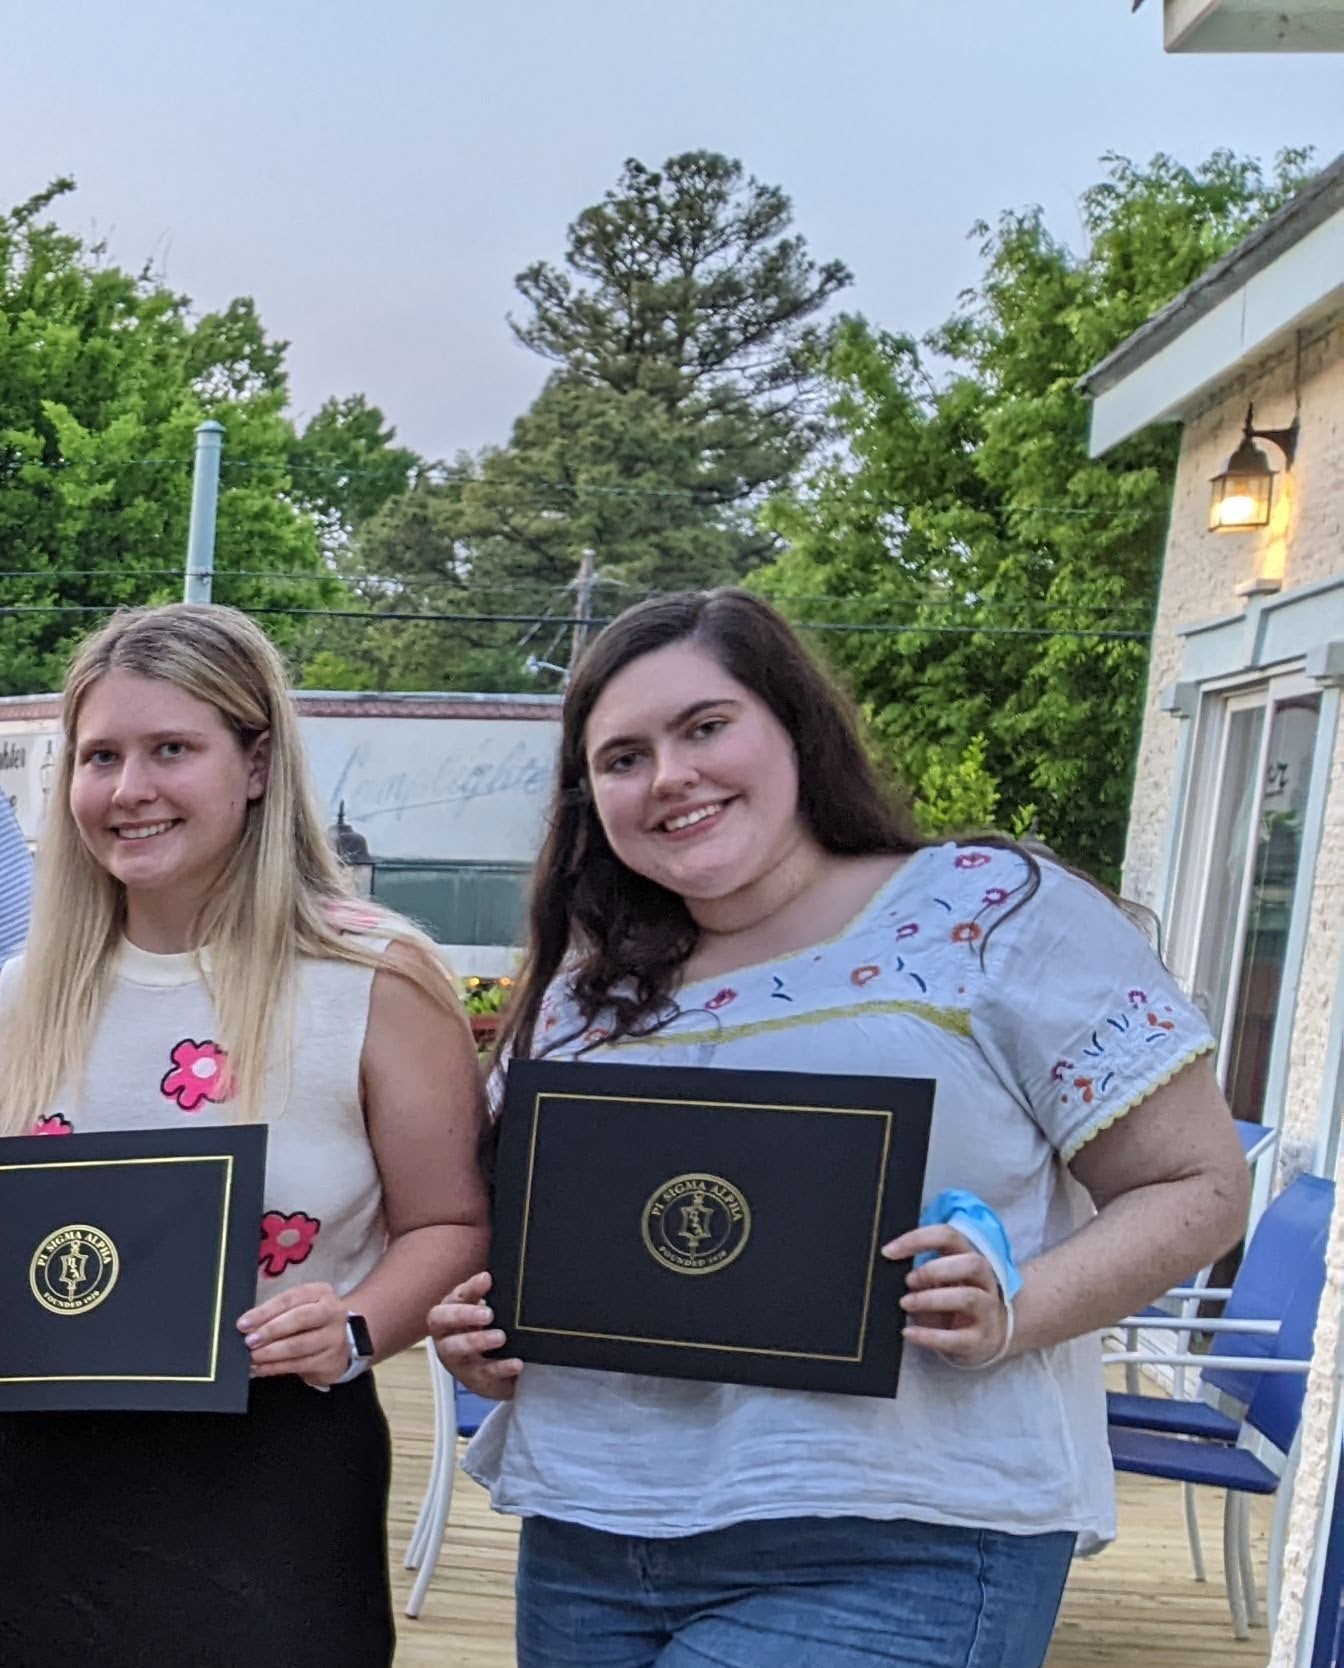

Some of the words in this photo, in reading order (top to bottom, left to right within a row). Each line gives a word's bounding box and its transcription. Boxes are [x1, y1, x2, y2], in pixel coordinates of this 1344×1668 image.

[652, 1203, 664, 1216] PI
[663, 1181, 706, 1201] SIGMA
[711, 1185, 743, 1221] ALPHA
[37, 1254, 48, 1267] PI
[46, 1231, 82, 1252] SIGMA
[84, 1234, 111, 1264] ALPHA
[44, 1292, 82, 1308] FOUNDED
